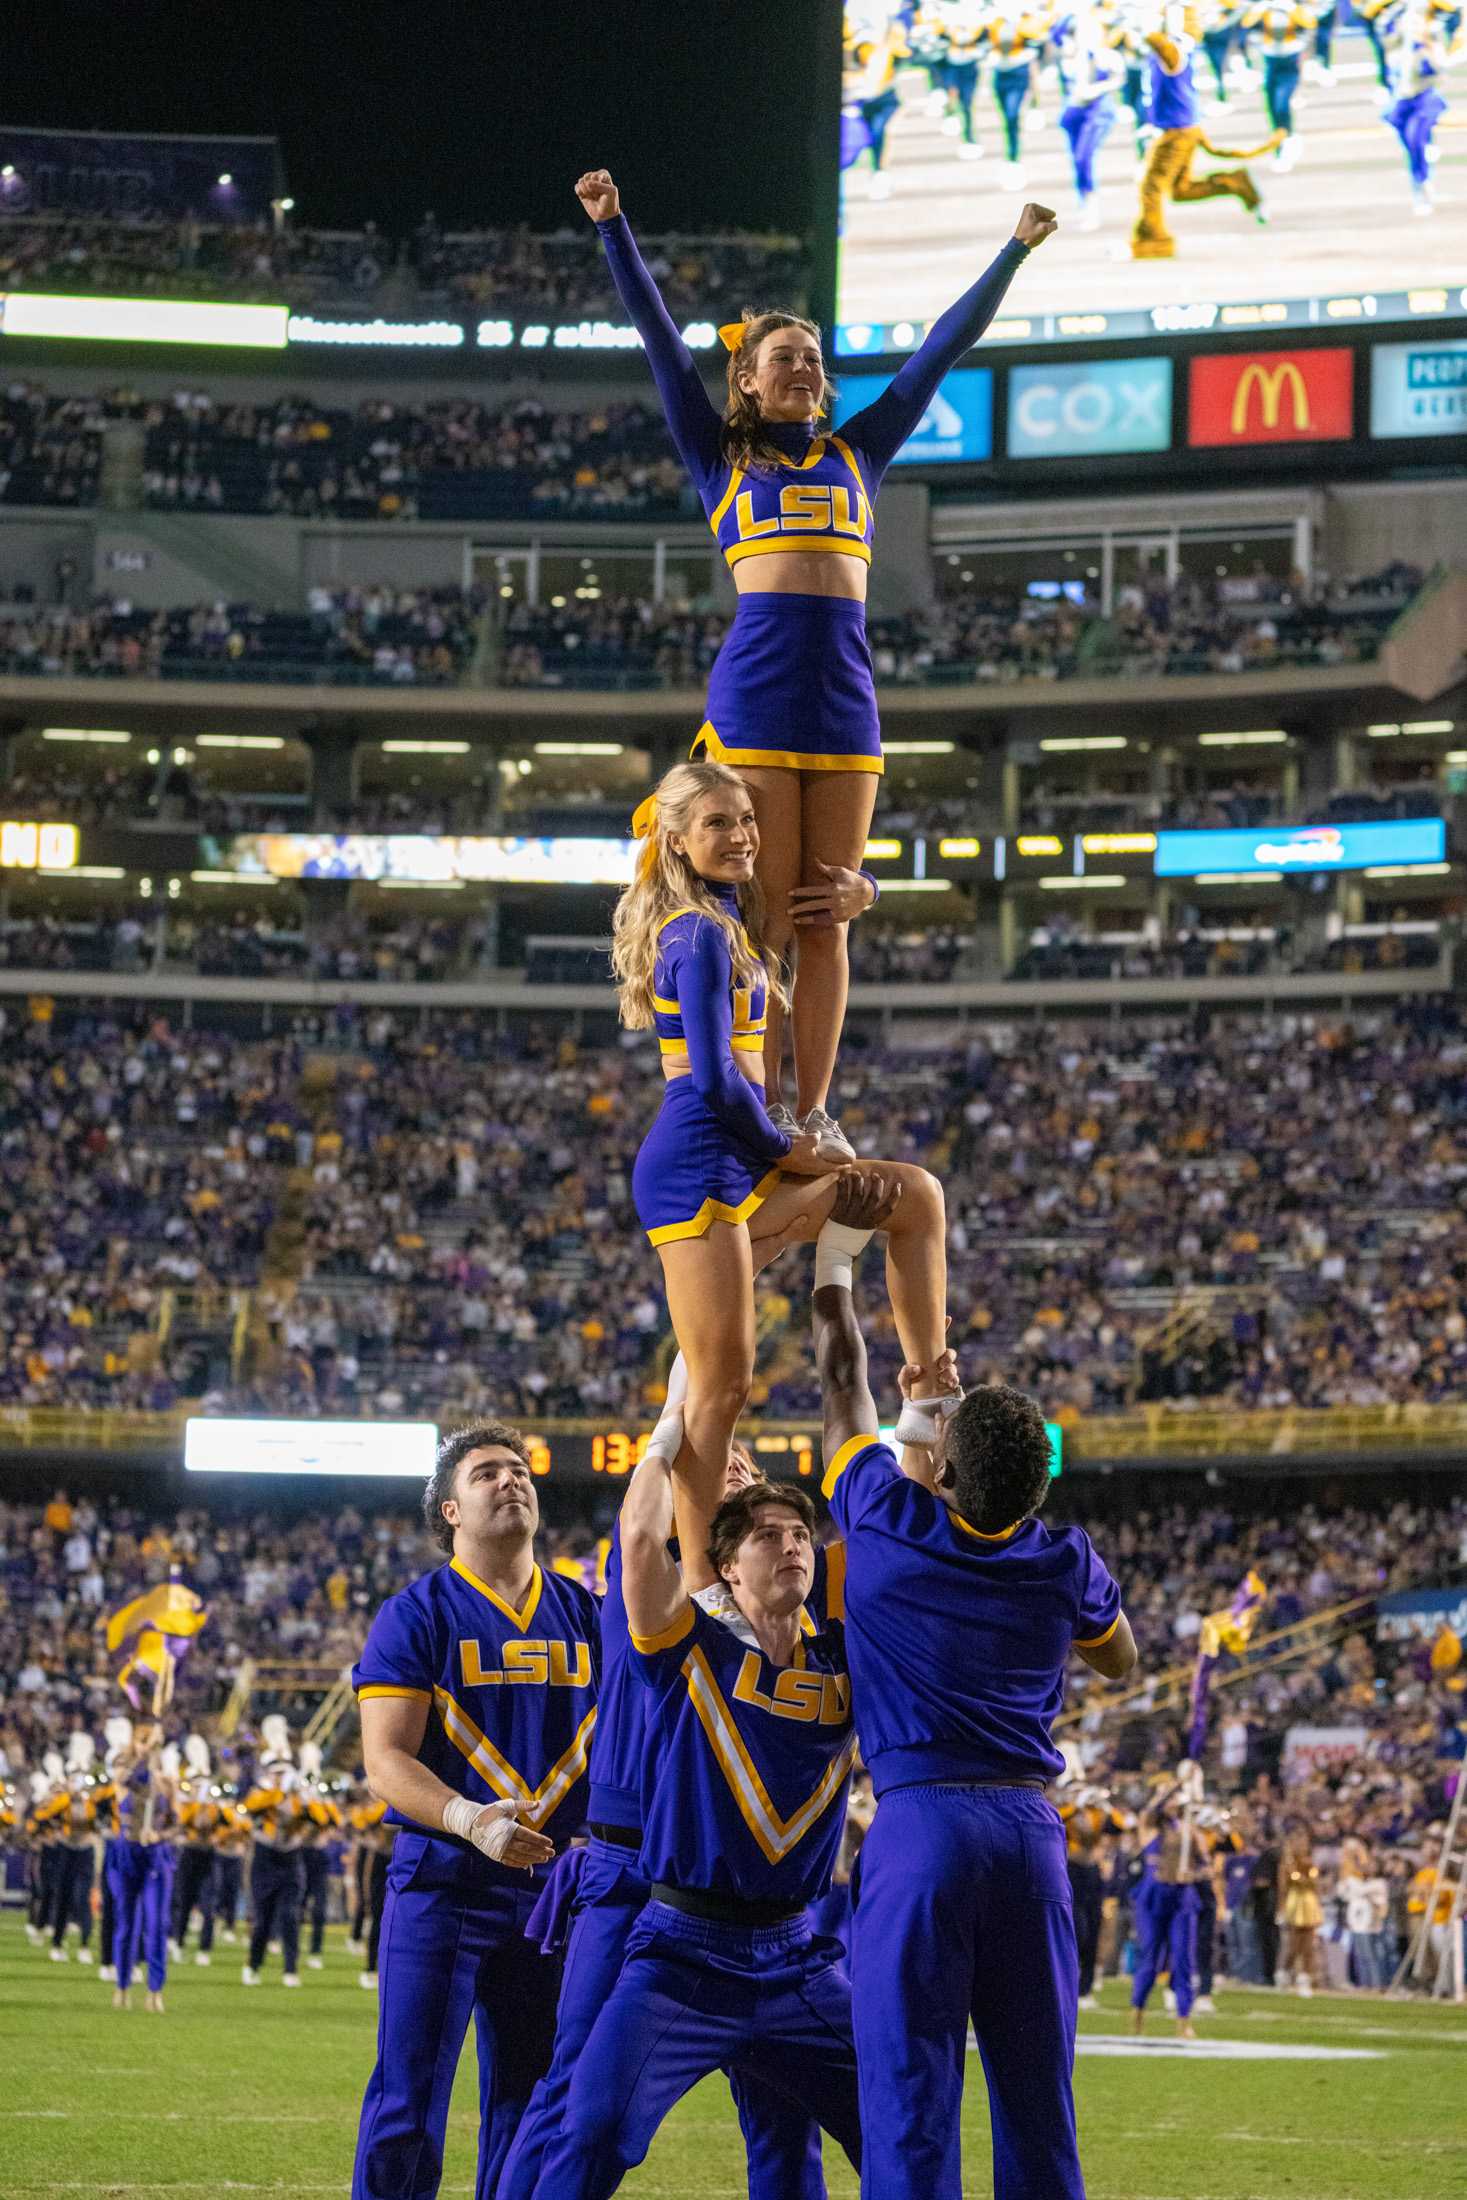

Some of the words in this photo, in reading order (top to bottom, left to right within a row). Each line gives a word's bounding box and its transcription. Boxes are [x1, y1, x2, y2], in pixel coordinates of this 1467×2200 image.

[1018, 381, 1162, 438] COX
[736, 484, 867, 541] LSU
[459, 1639, 592, 1689] LSU
[731, 1649, 851, 1726] LSU
